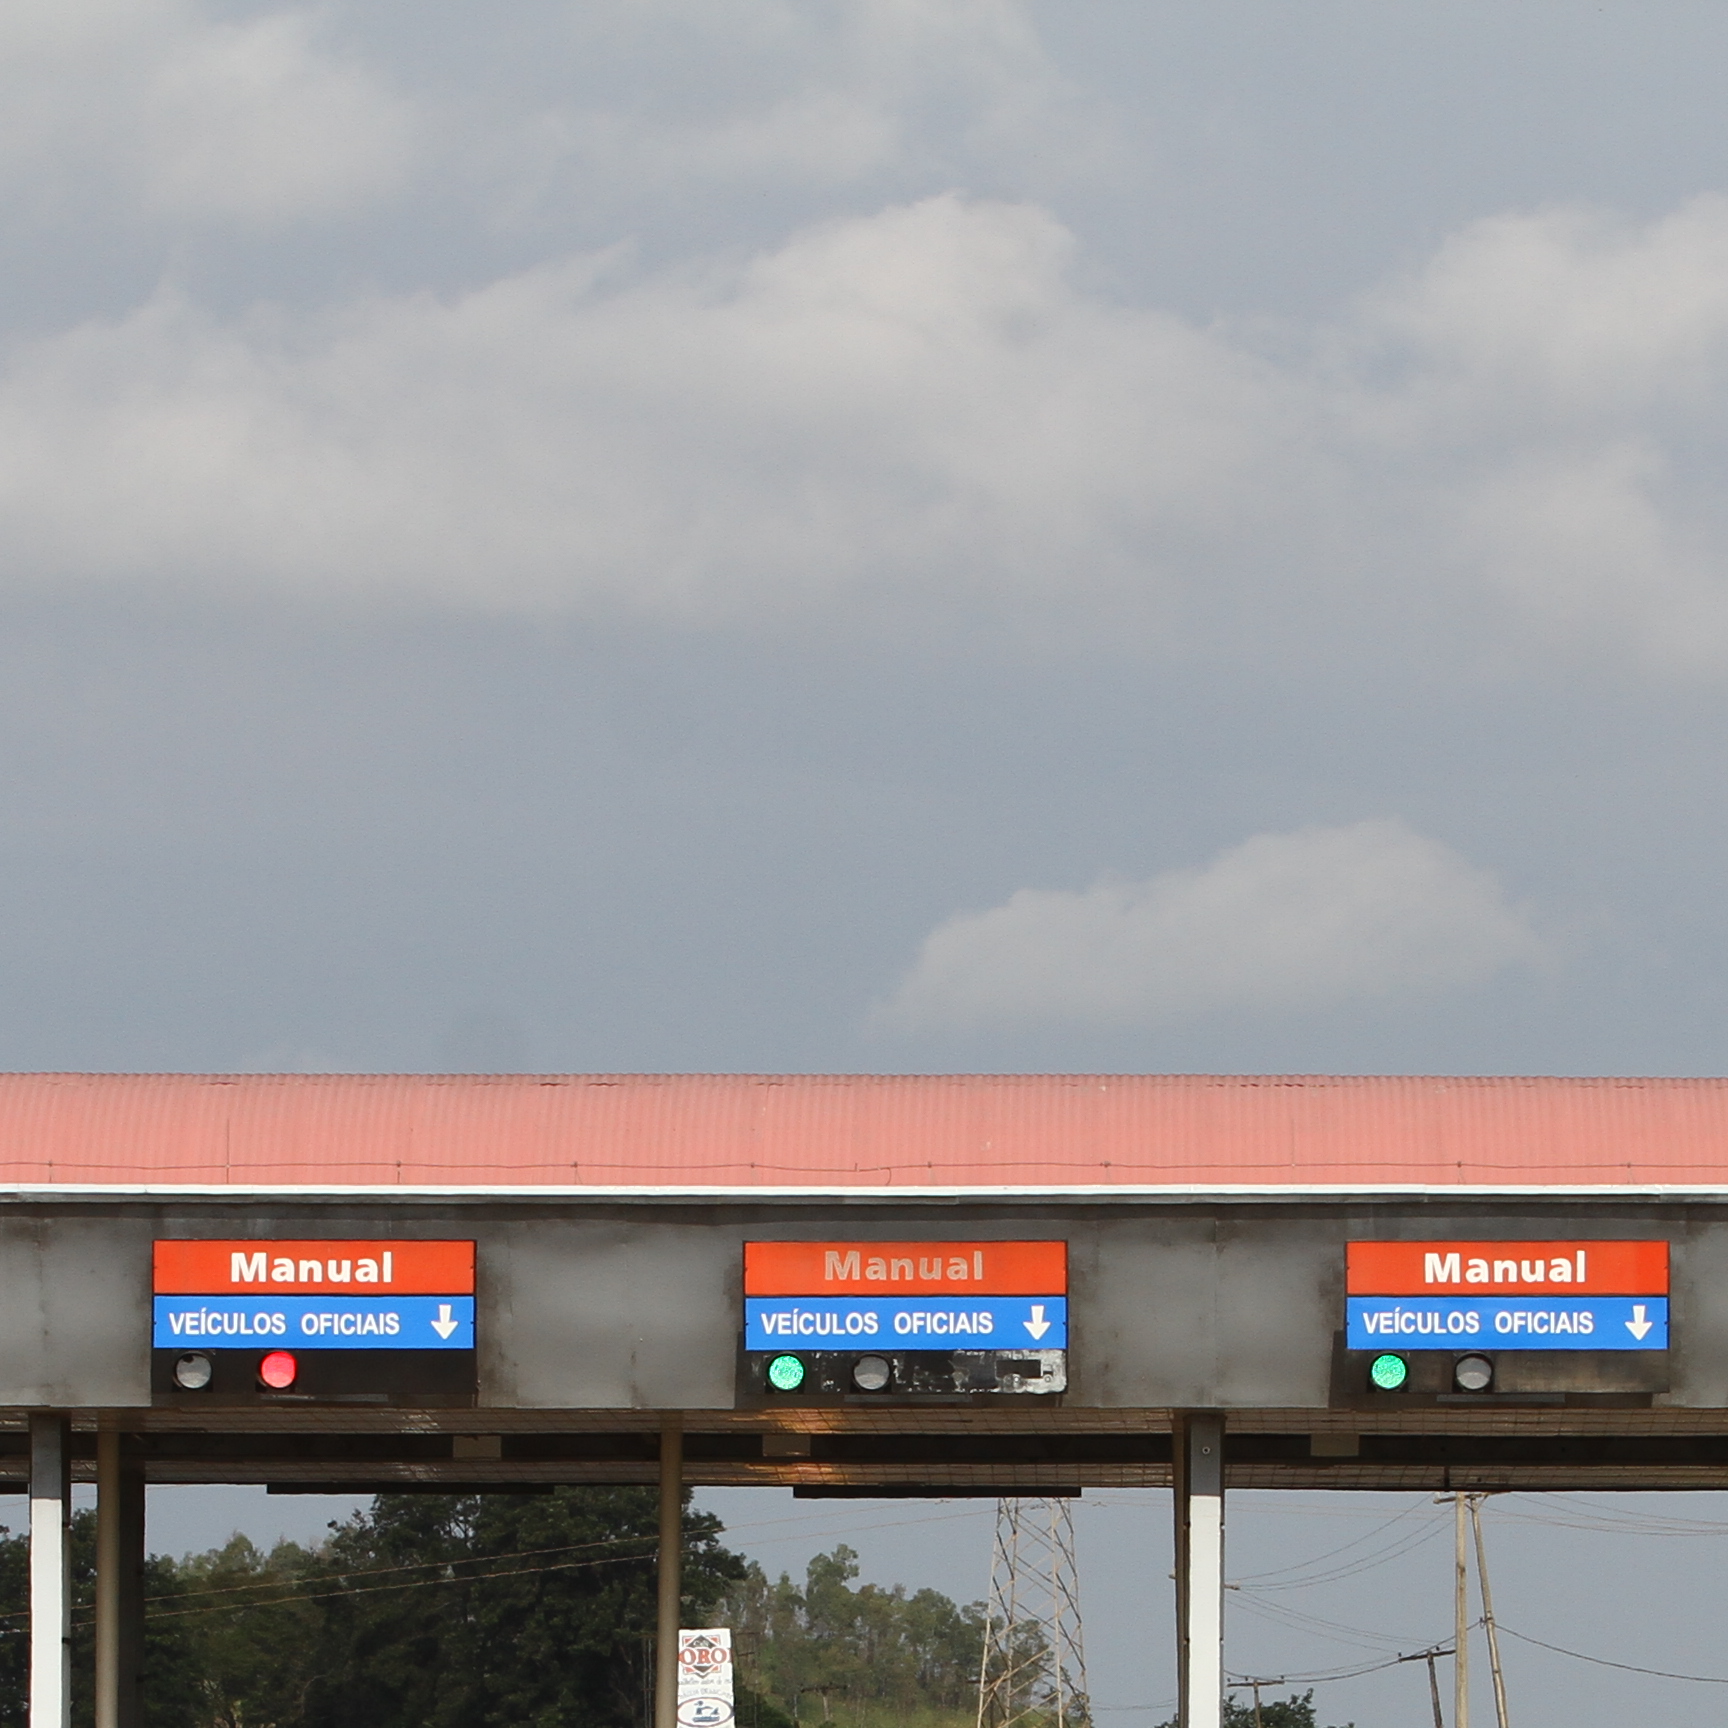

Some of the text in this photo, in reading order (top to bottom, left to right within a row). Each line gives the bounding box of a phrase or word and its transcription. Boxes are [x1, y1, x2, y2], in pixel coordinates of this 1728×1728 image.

[230, 1251, 393, 1283] Manual
[824, 1250, 984, 1281] Manual
[1424, 1250, 1587, 1283] Manual
[168, 1307, 401, 1336] VEÍCULOS OFICIAIS
[761, 1308, 994, 1336] VEÍCULOS OFICIAIS
[1362, 1306, 1595, 1335] VEÍCULOS OFICIAIS
